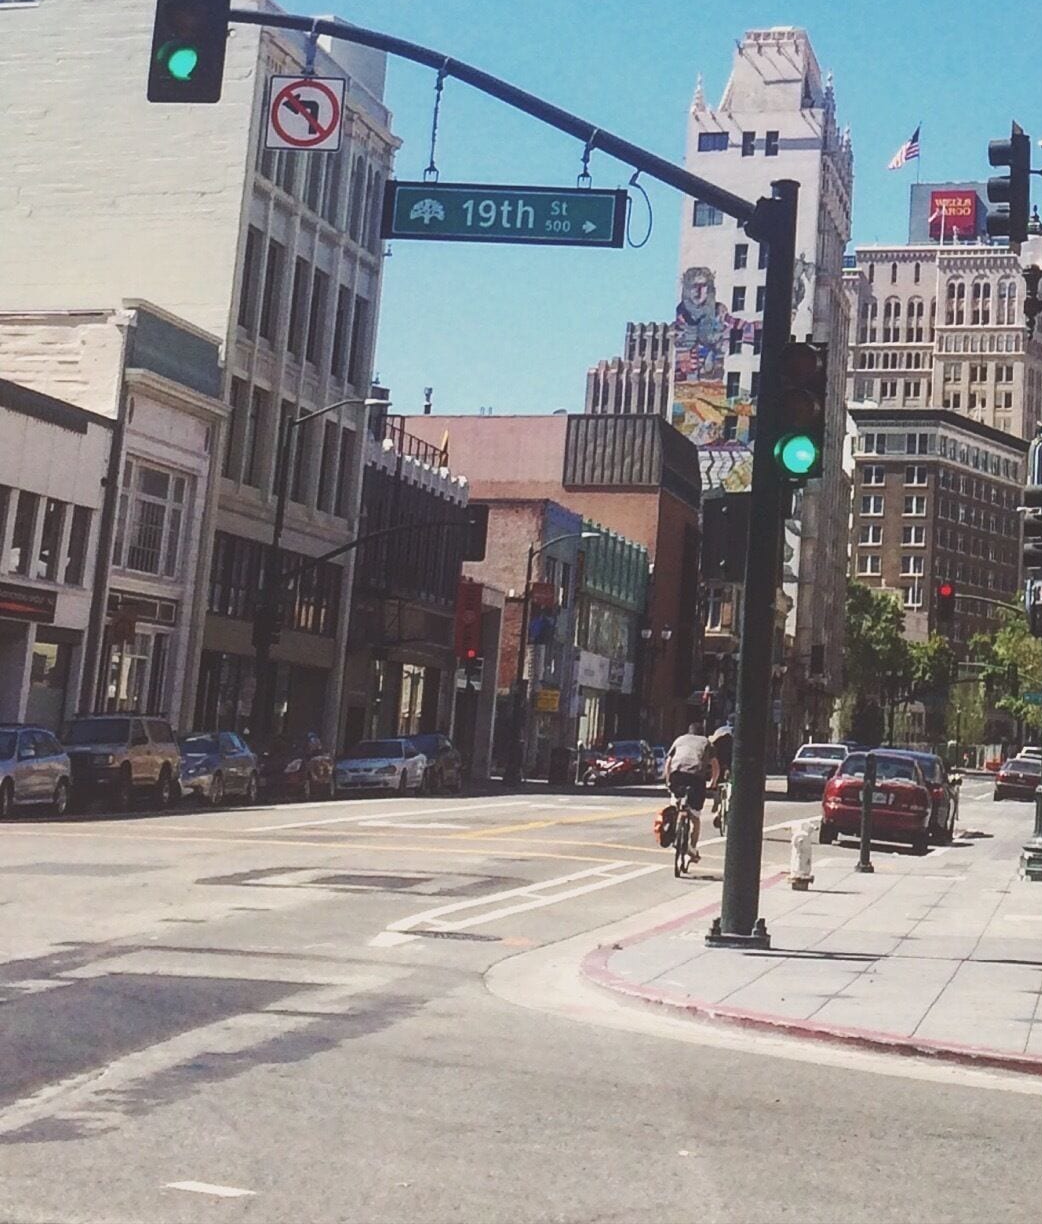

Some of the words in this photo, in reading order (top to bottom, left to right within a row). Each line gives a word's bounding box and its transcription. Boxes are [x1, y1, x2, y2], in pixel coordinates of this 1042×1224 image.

[462, 199, 535, 229] 19th
[551, 201, 568, 216] St
[545, 220, 571, 233] 500
